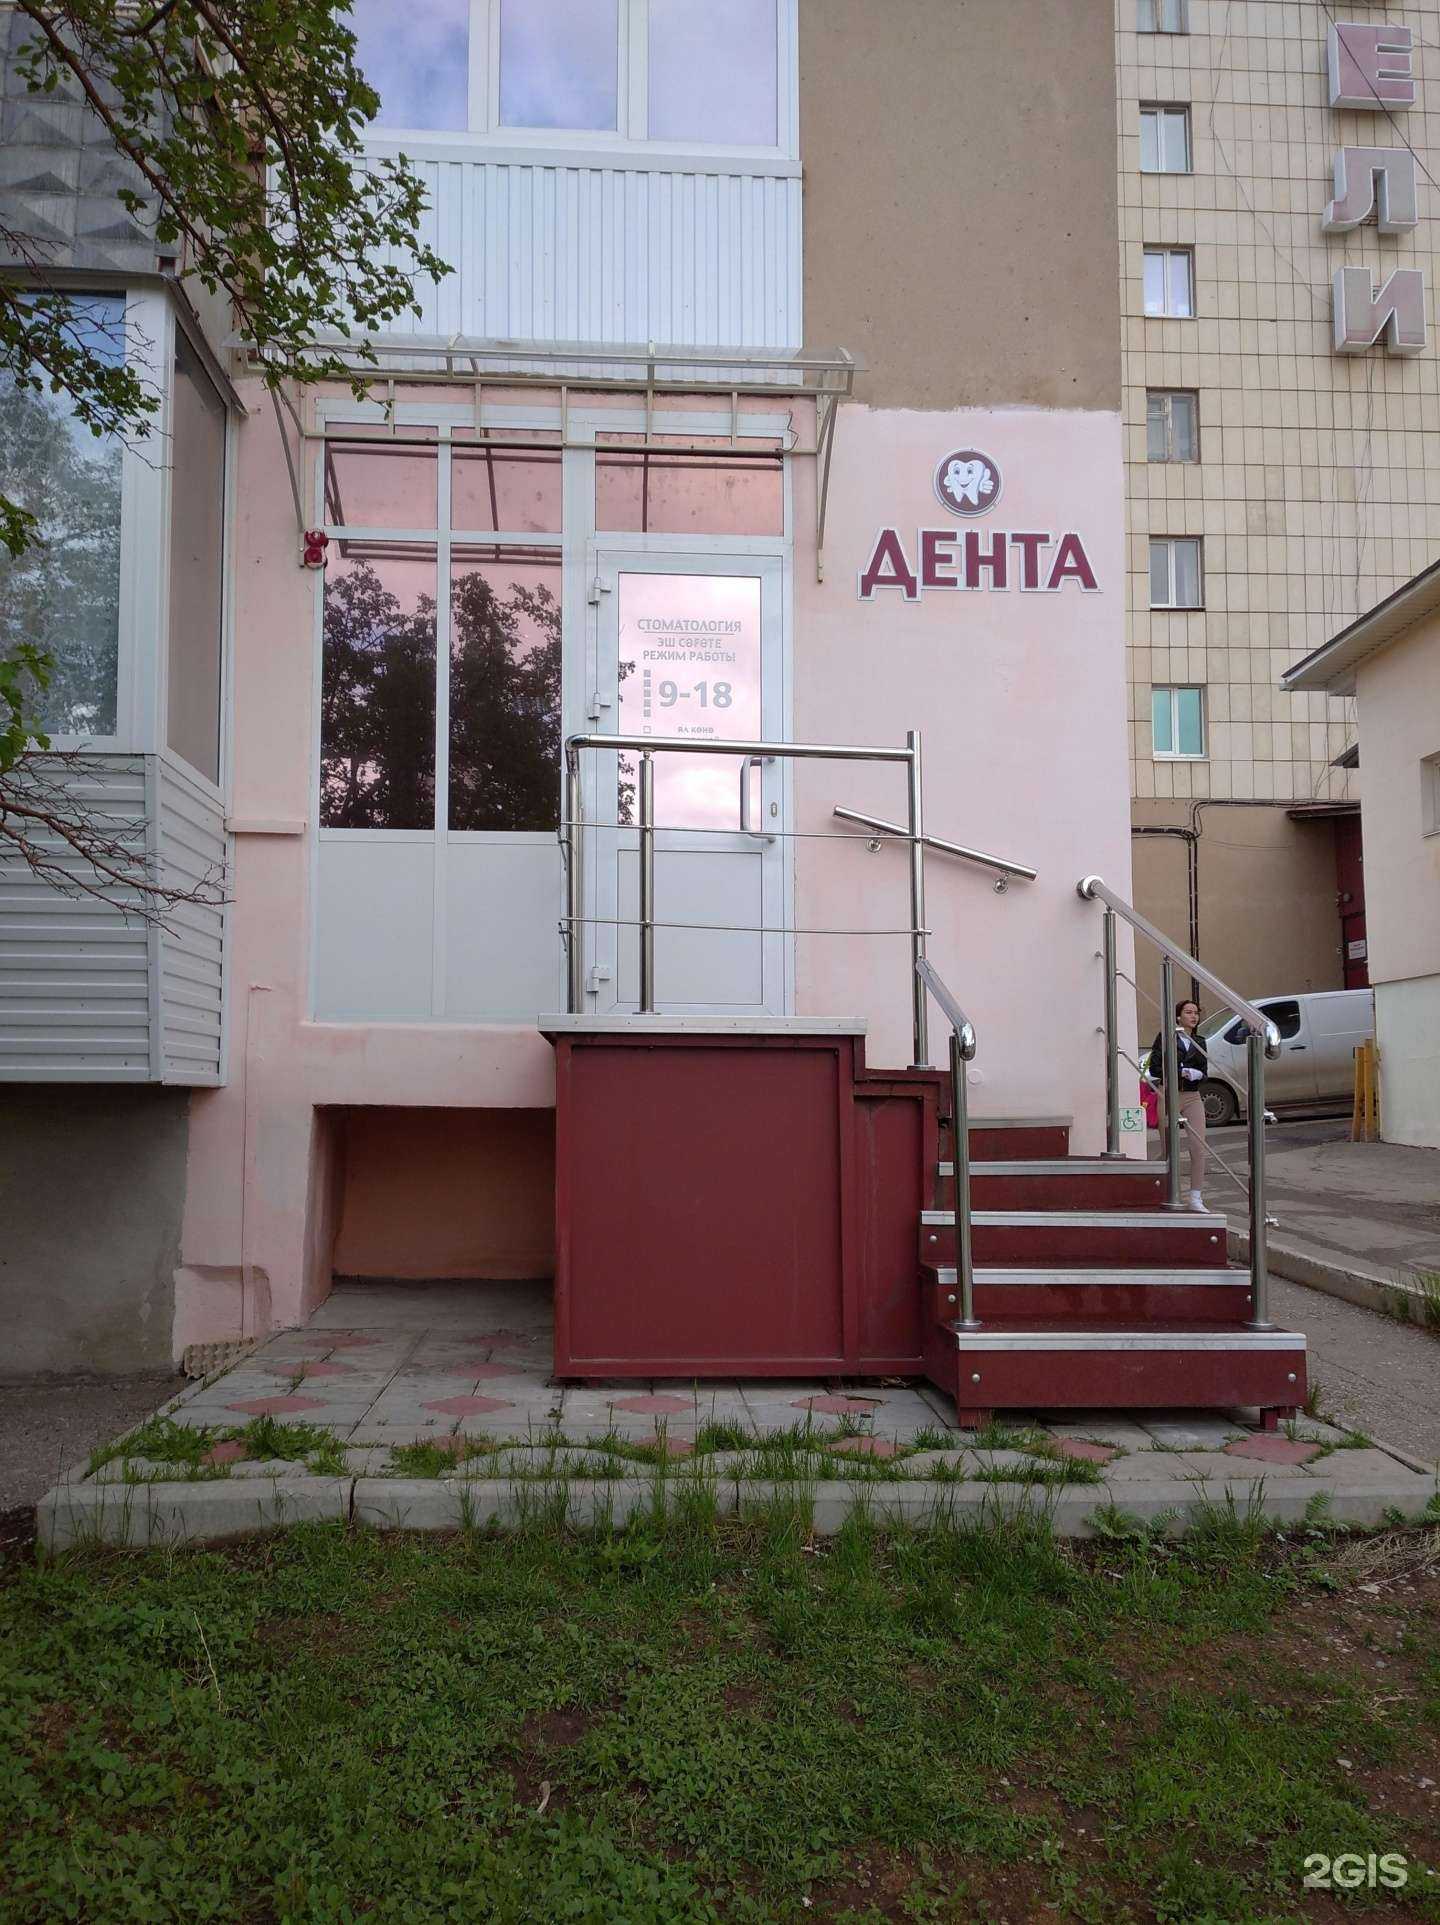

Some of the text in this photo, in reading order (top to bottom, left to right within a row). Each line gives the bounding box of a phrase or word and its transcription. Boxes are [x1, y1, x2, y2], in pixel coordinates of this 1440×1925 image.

[859, 528, 1100, 599] ДЕНТА
[638, 619, 742, 632] СТОМАТОЛОГИЯ
[656, 637, 676, 648] ЭШ
[643, 650, 736, 662] РЕЖИМ РАБОТЫ
[658, 680, 732, 708] 9-18
